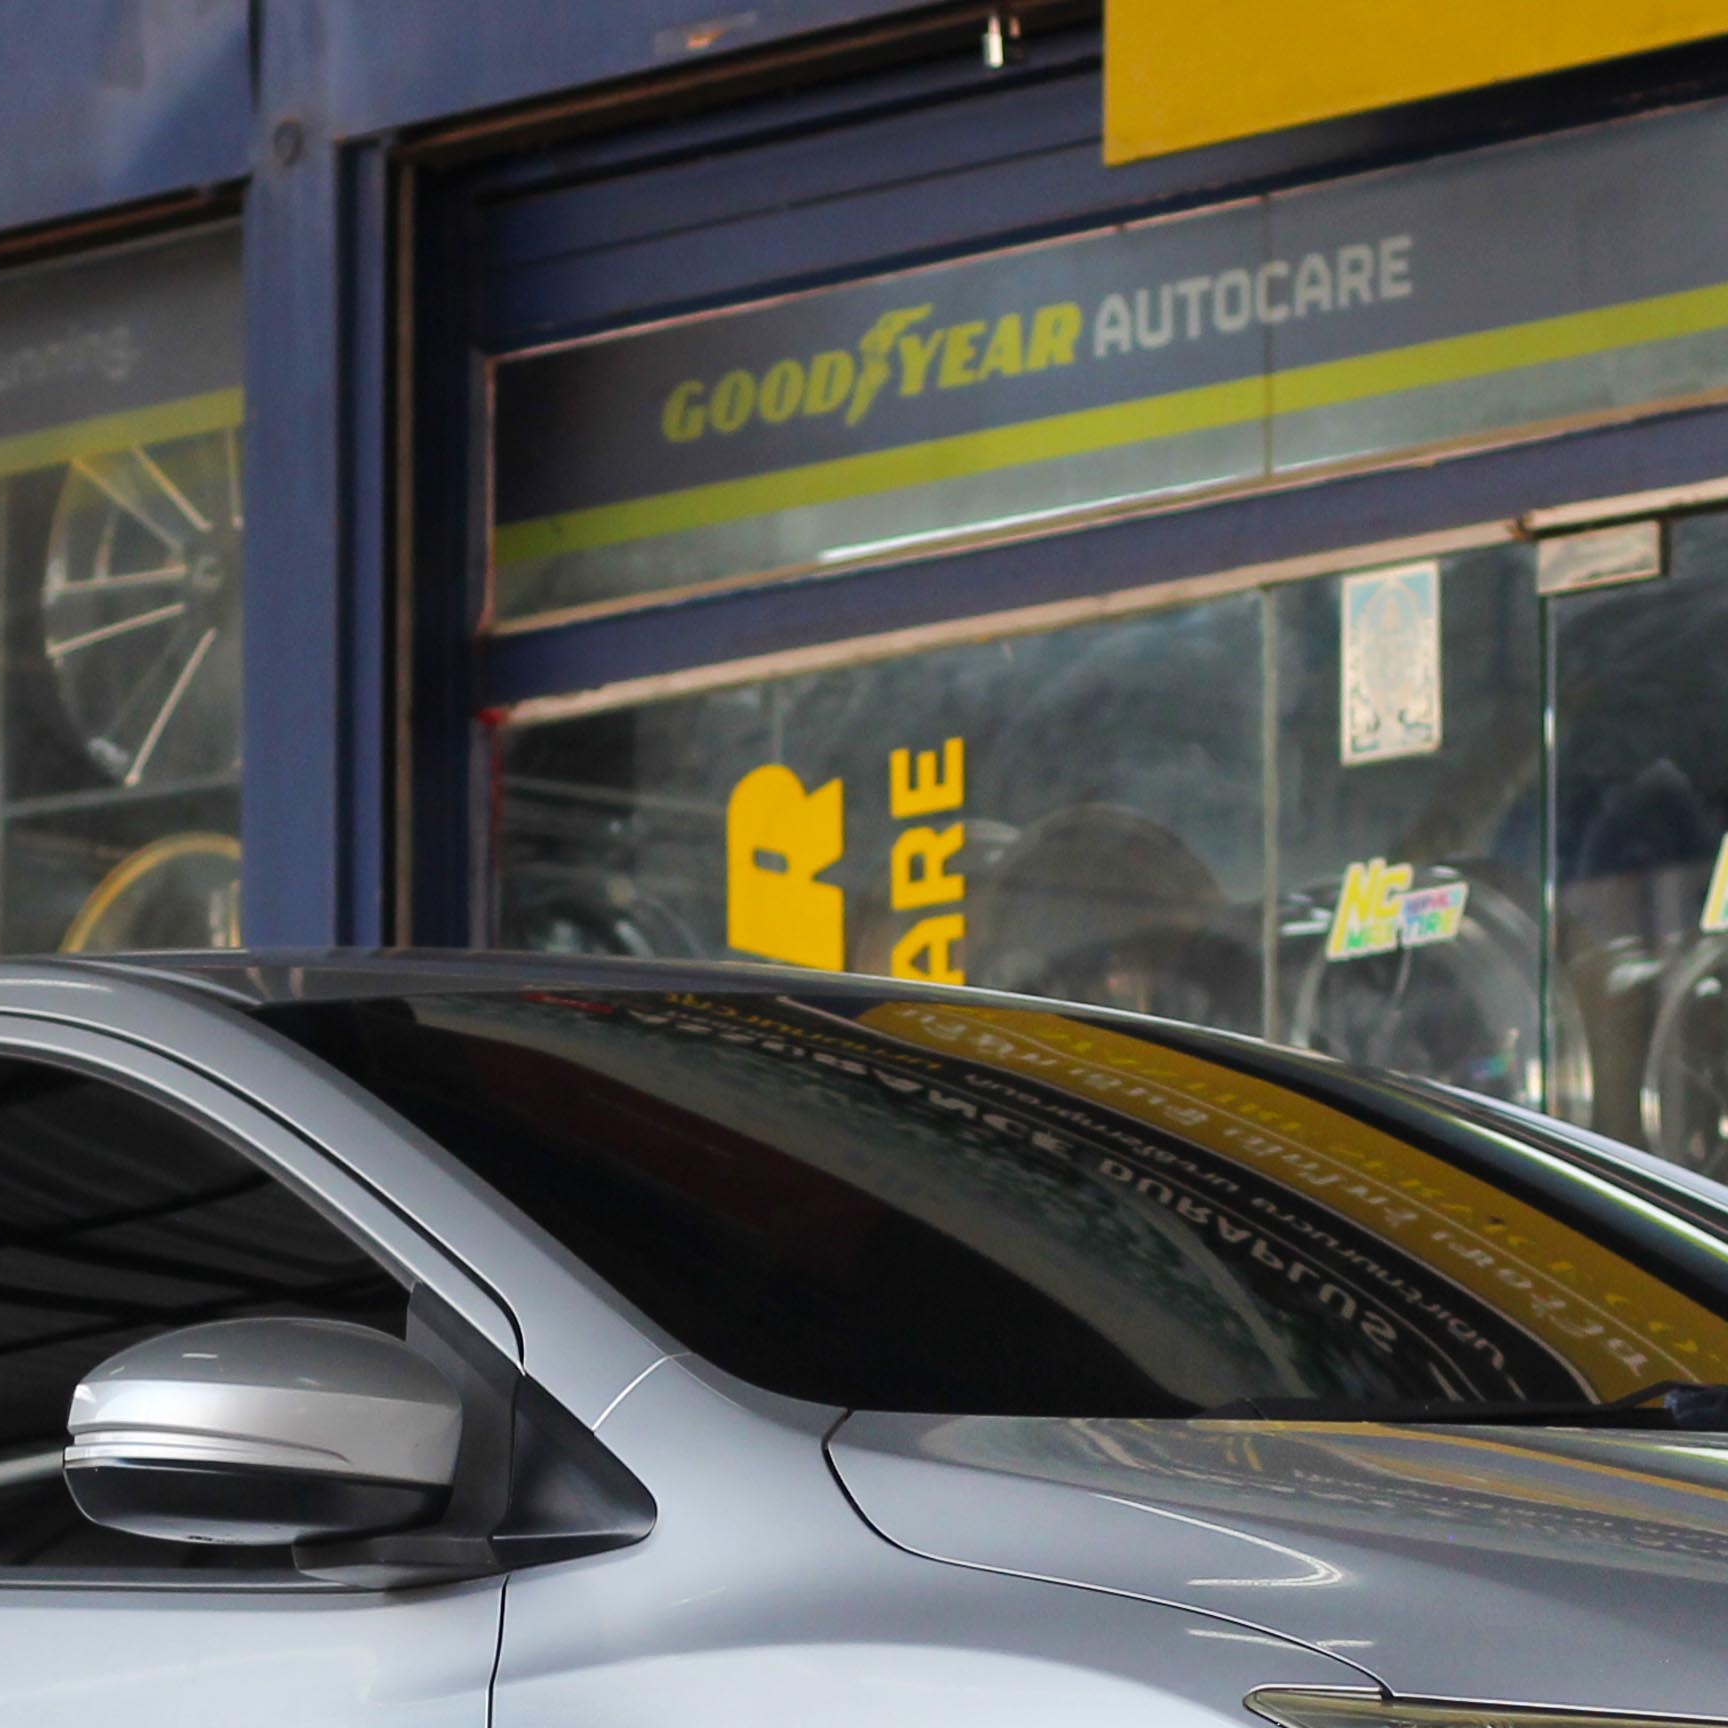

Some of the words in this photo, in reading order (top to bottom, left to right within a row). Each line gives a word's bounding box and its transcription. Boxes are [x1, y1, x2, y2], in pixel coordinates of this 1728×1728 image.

[662, 303, 1083, 443] GOODYEAR
[1092, 235, 1414, 359] AUTOCARE
[1330, 862, 1410, 953] NC
